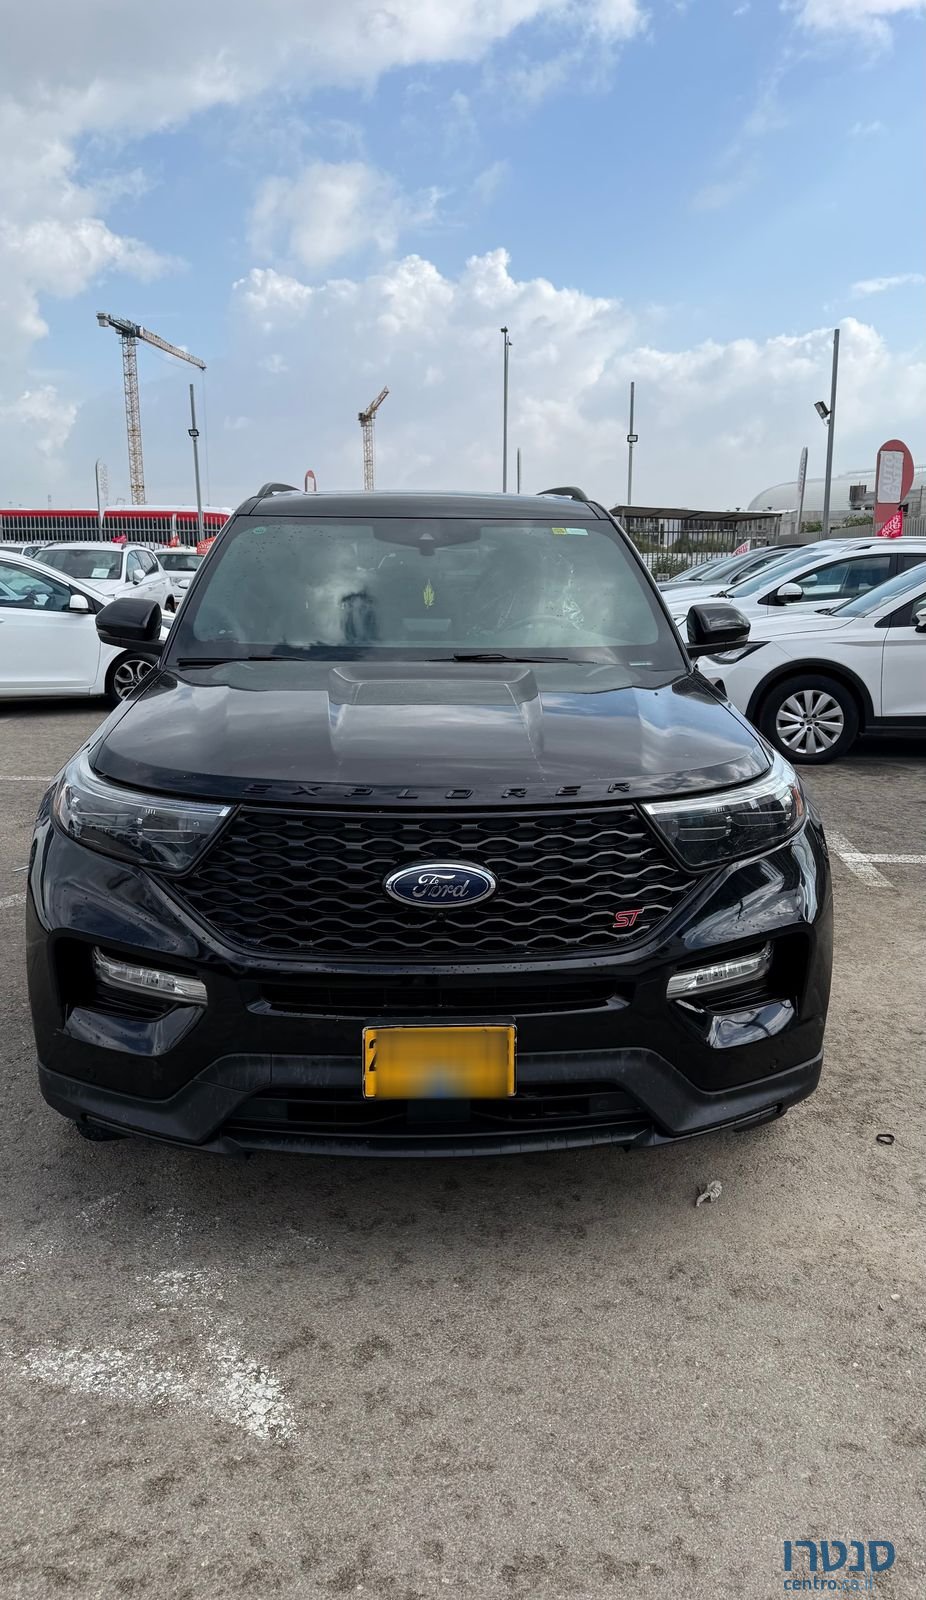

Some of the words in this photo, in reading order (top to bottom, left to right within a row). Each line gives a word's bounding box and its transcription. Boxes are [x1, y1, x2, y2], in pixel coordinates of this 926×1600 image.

[242, 782, 632, 799] EXPLORER
[412, 873, 470, 897] Ford
[612, 909, 645, 928] ST
